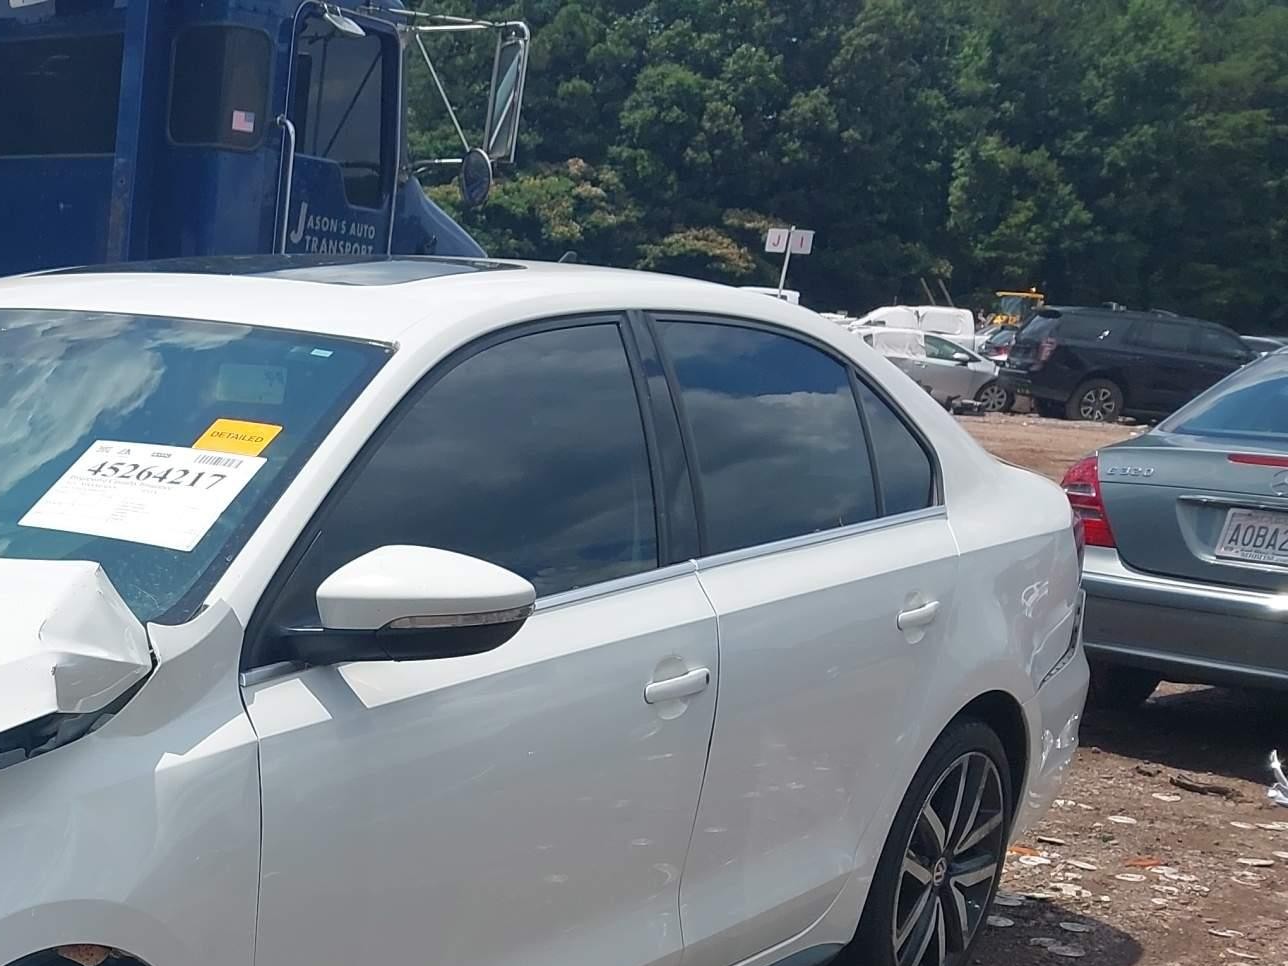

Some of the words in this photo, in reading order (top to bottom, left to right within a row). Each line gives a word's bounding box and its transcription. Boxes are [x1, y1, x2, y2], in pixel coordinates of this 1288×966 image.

[349, 222, 376, 240] AUTO
[304, 235, 374, 256] TRANSPORT
[772, 234, 781, 247] J
[210, 430, 264, 443] DETAILED
[88, 460, 227, 490] 45264217
